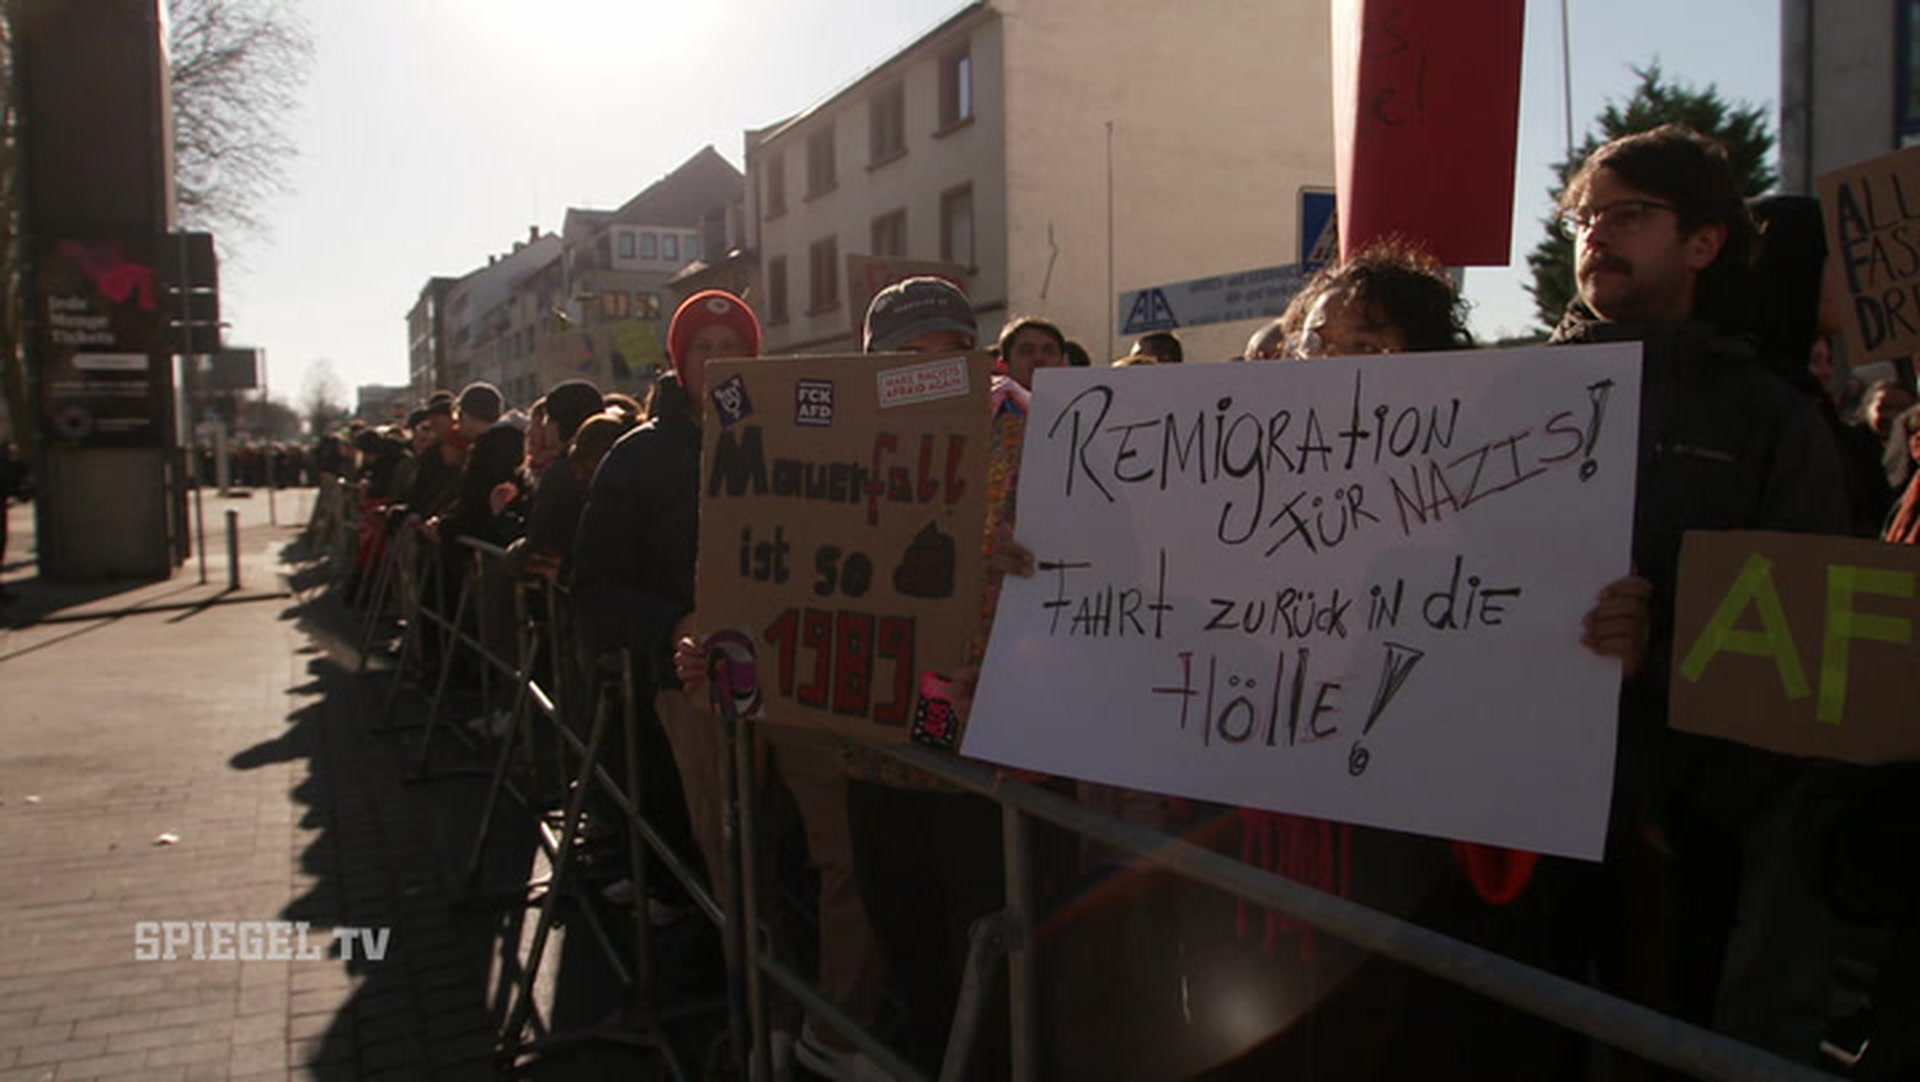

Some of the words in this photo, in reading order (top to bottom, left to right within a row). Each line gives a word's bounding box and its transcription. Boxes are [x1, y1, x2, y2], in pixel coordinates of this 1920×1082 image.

[798, 388, 832, 403] FCK
[798, 403, 832, 419] AFD
[739, 524, 791, 585] ist
[762, 606, 918, 728] 1989
